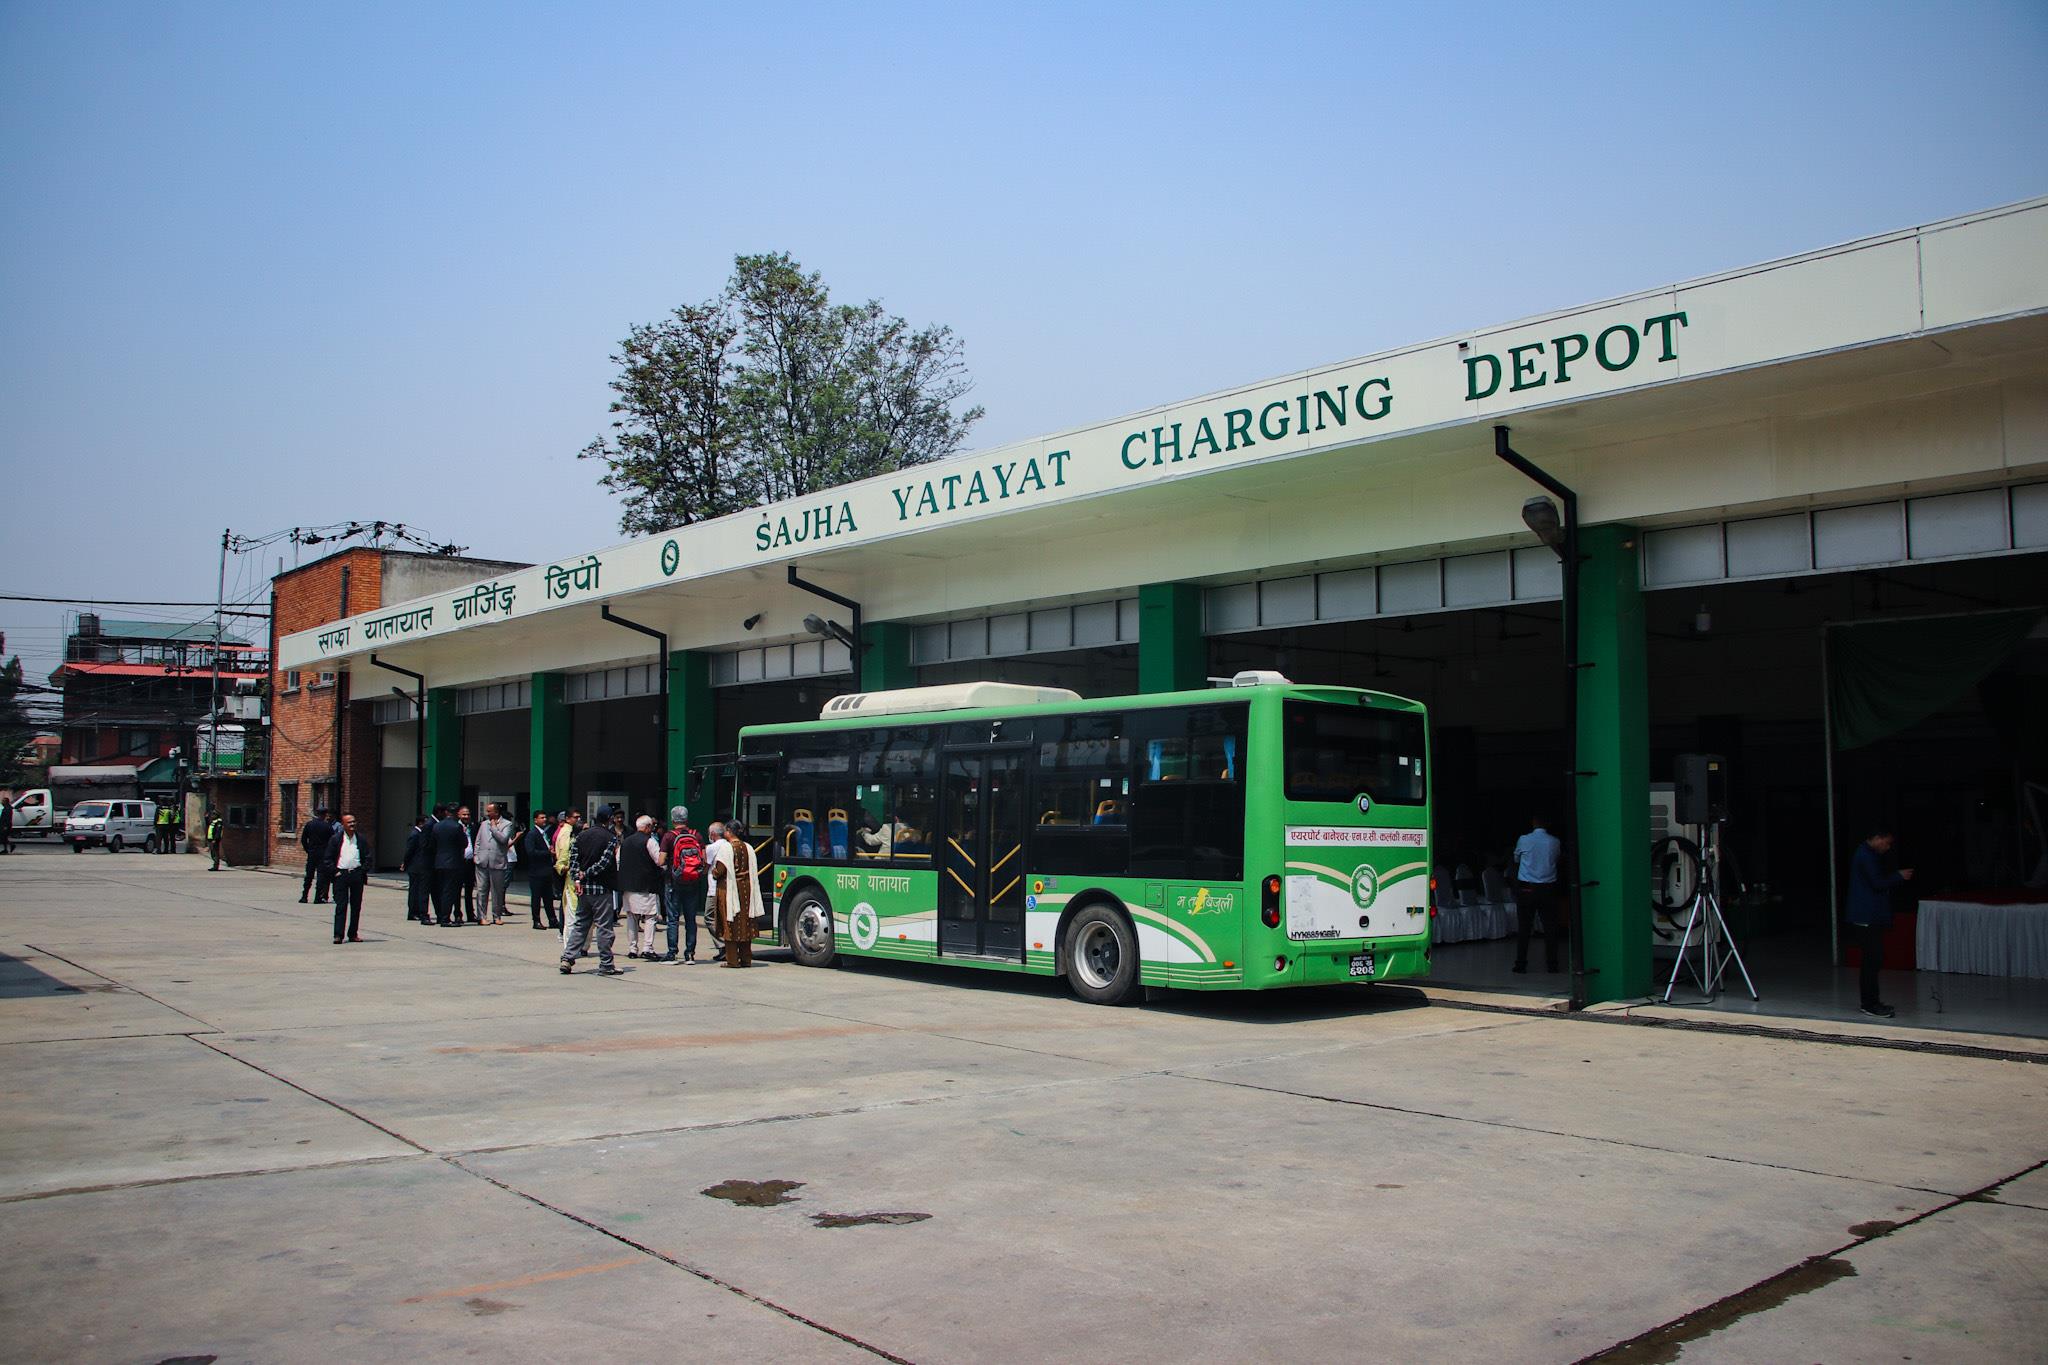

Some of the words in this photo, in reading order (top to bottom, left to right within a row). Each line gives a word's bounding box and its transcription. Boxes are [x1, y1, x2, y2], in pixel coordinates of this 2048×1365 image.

[756, 501, 858, 552] SAJHA
[892, 450, 1071, 521] YATAYAT
[1121, 377, 1394, 470] CHARGING
[1463, 311, 1688, 402] DEPOT
[318, 627, 351, 655] साझा
[364, 606, 434, 640] यातायात
[836, 873, 861, 890] साझा
[867, 875, 912, 893] यातायात
